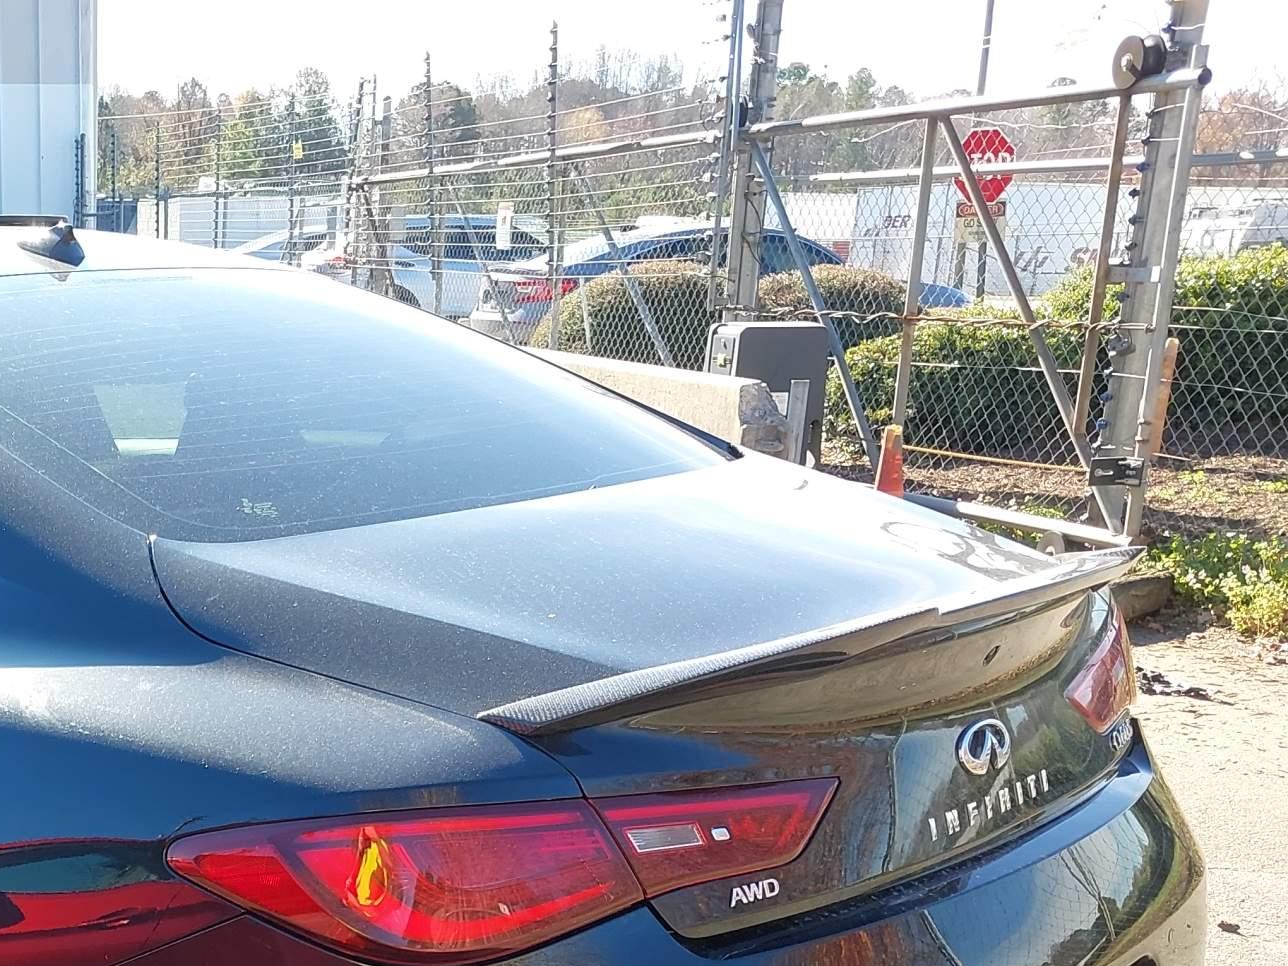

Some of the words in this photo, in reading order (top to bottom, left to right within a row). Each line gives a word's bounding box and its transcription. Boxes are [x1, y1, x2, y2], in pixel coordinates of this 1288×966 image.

[959, 151, 1012, 180] TOP
[964, 204, 998, 214] DAER
[928, 769, 1049, 842] INFINITI
[730, 878, 780, 908] AWD
